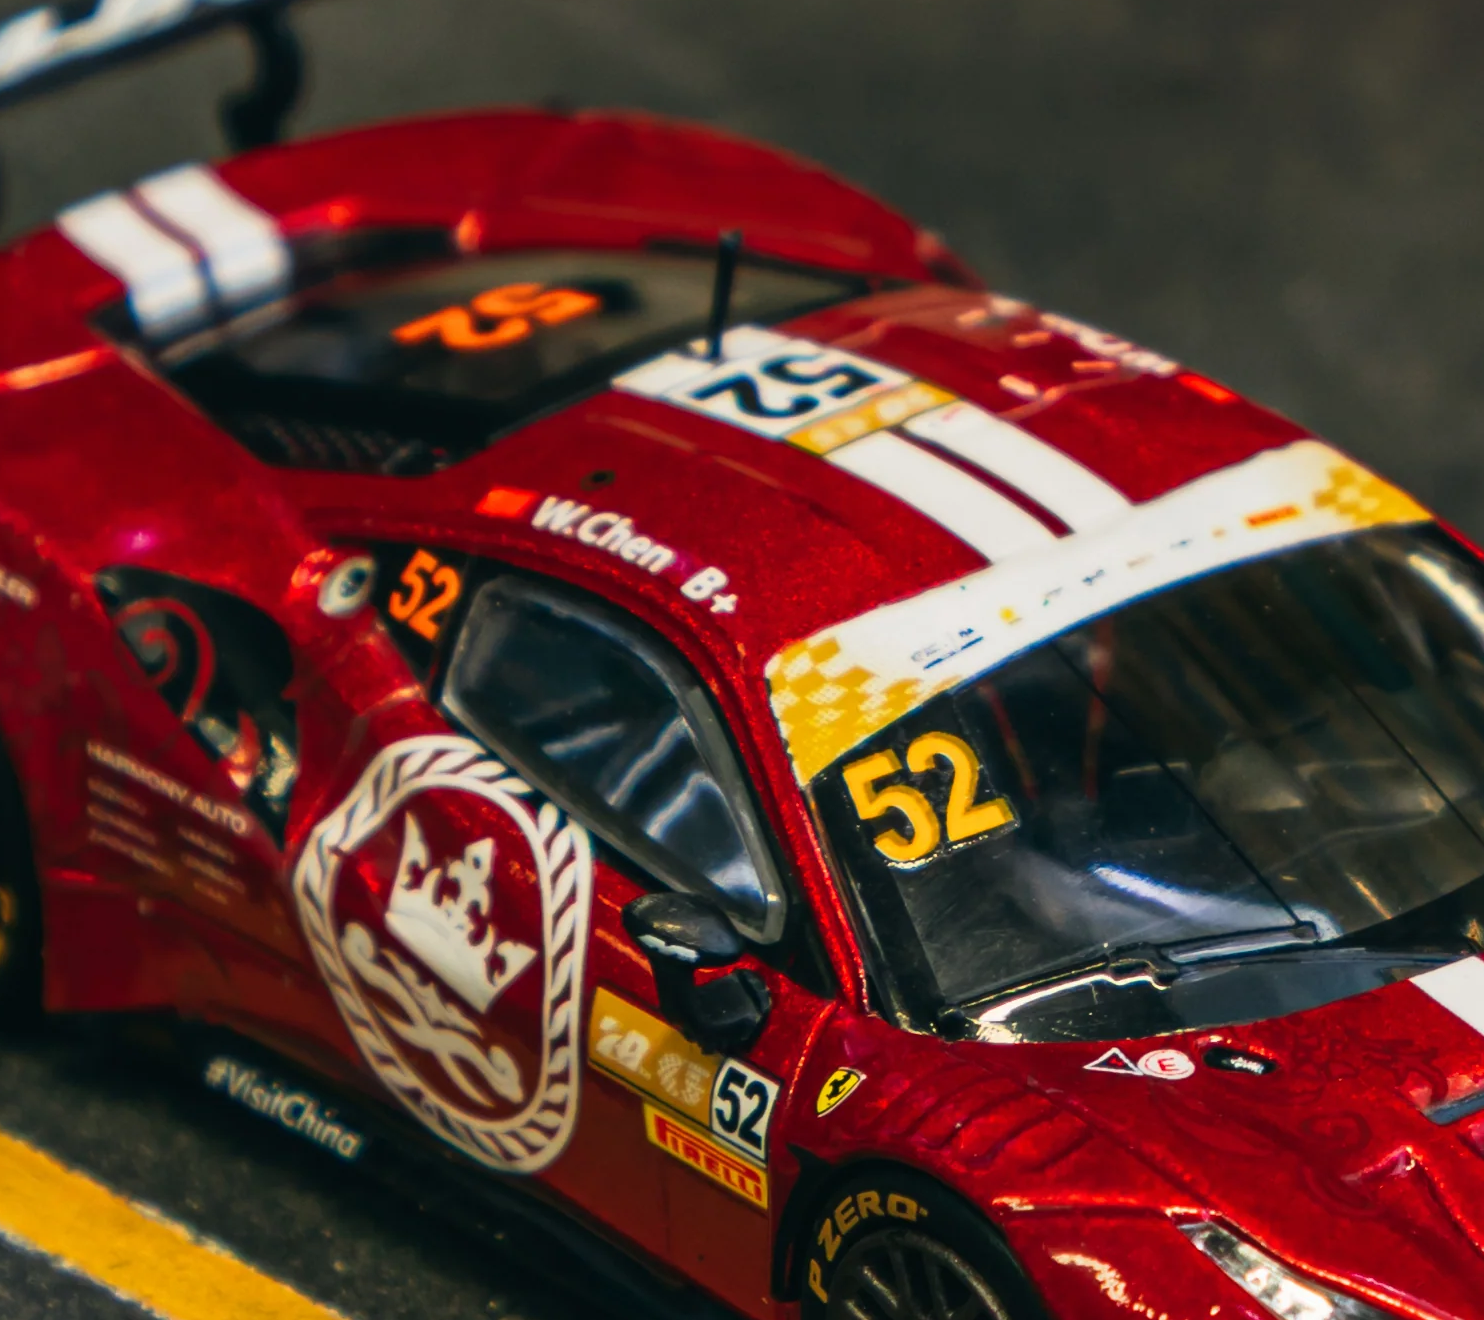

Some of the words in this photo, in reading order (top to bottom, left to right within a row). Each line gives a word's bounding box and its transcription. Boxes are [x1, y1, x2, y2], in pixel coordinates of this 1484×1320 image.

[391, 283, 600, 349] 52
[689, 354, 883, 418] 52
[388, 549, 461, 641] 52
[531, 495, 677, 574] W.Chen
[680, 566, 738, 614] B+
[192, 795, 248, 835] AUTO
[842, 731, 1014, 862] 52
[206, 1059, 361, 1158] #VisitChina
[715, 1066, 769, 1151] 52
[654, 1113, 762, 1202] PIRELLI
[808, 1259, 828, 1303] P
[818, 1190, 918, 1261] ZERO
